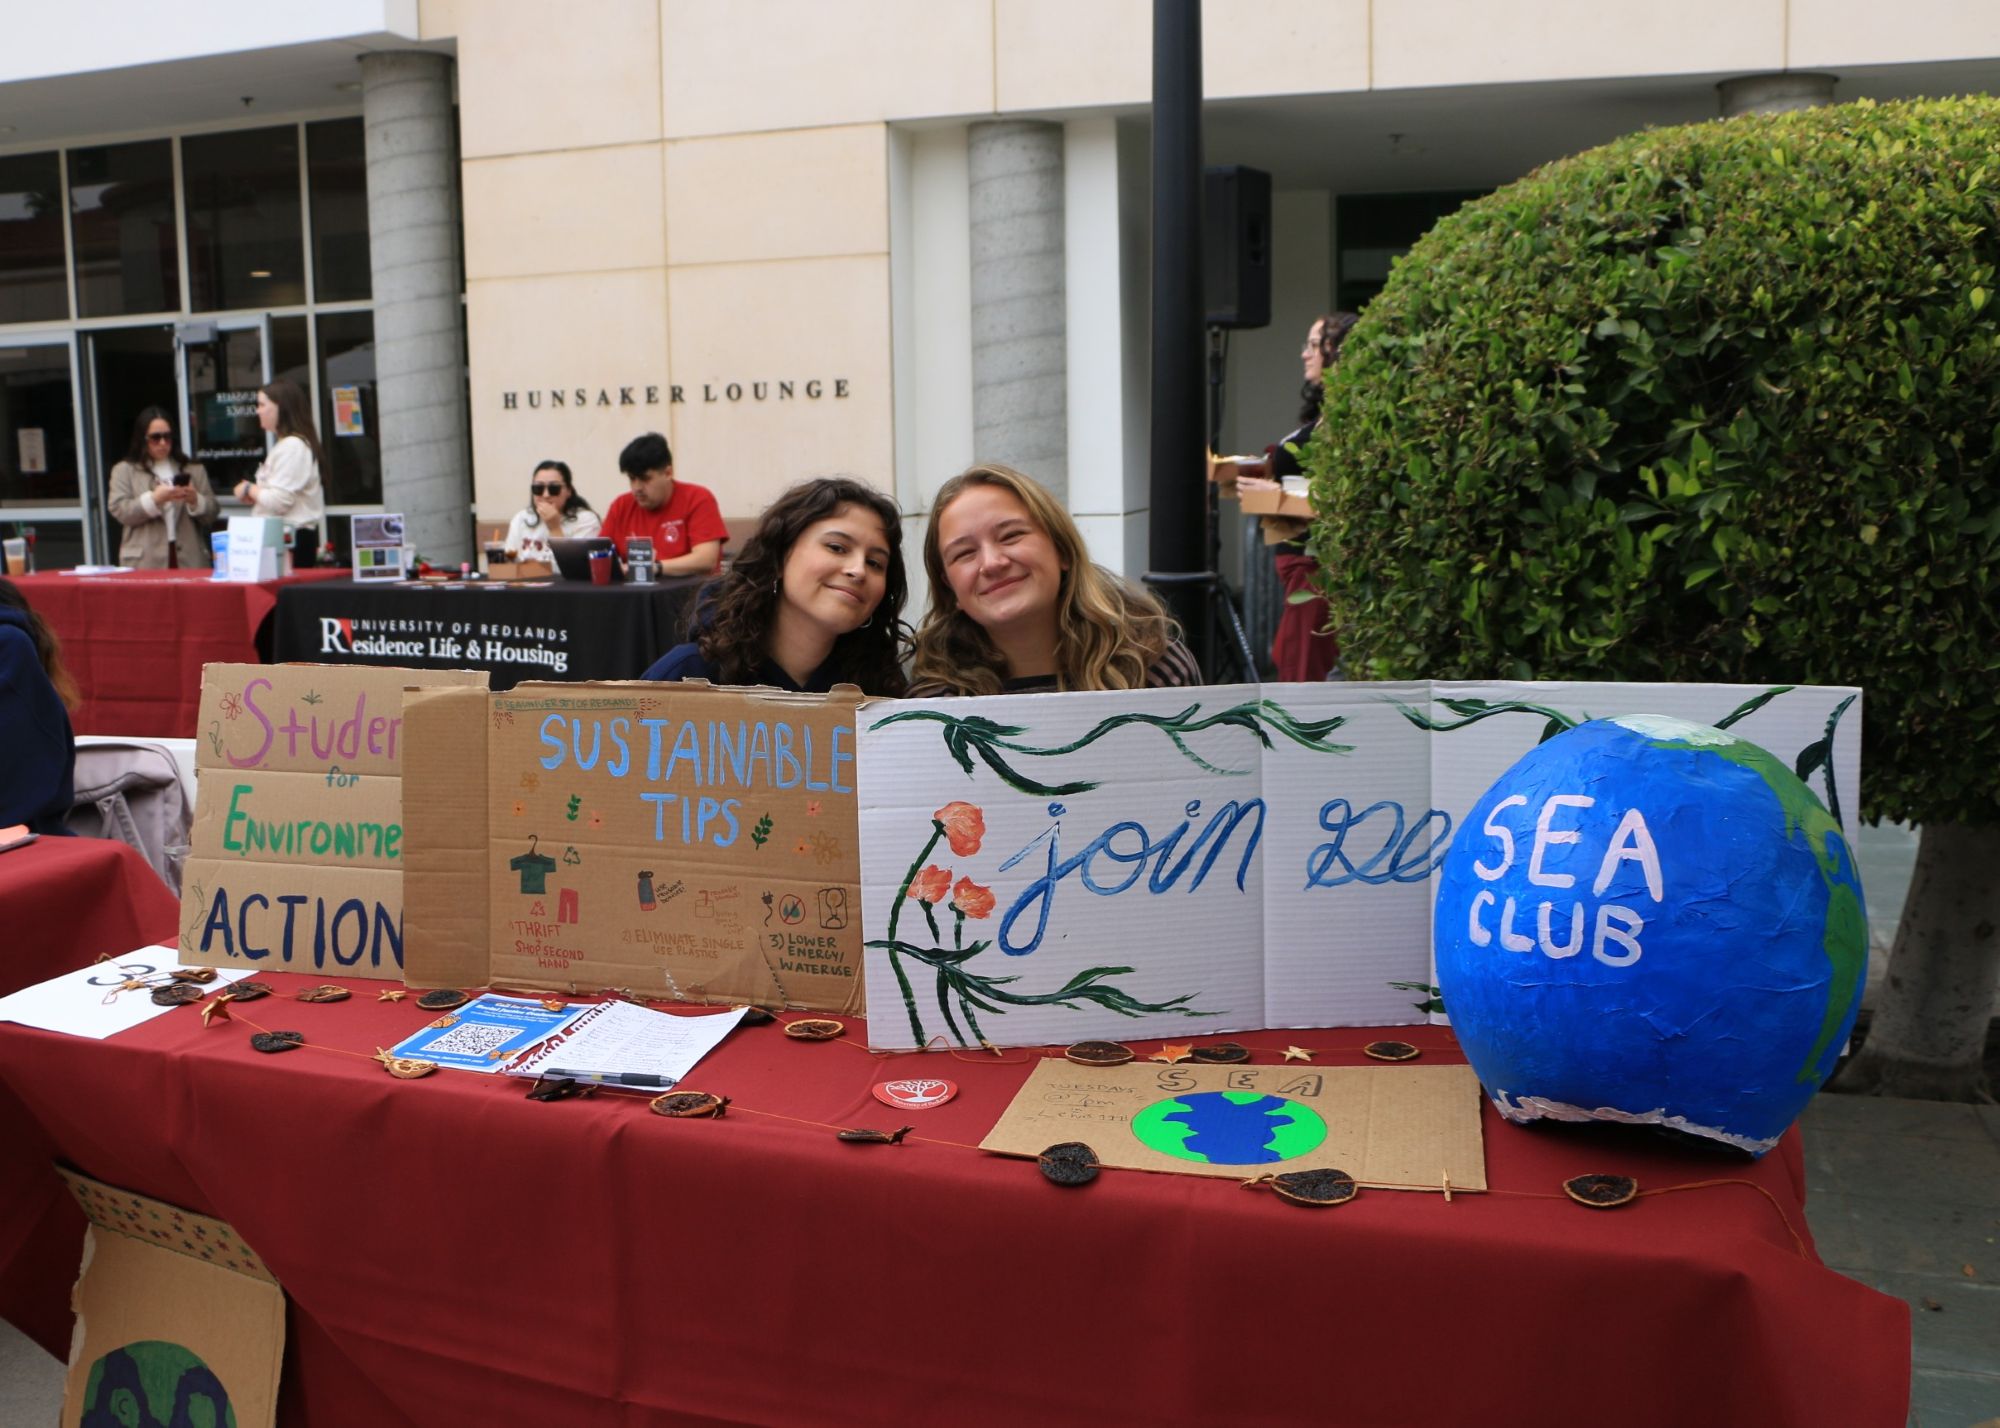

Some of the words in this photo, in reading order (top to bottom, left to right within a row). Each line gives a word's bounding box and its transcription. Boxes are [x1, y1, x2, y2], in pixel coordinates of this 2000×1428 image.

[503, 386, 686, 410] HUNSAKER
[704, 379, 849, 402] LOUNGE
[351, 619, 444, 635] UNIVERSITY
[452, 622, 473, 635] OF
[480, 624, 568, 642] REDLANDS
[319, 617, 425, 657] Residence
[429, 637, 462, 659] Life
[466, 640, 481, 660] &
[484, 641, 568, 673] Housing
[538, 713, 854, 793] SUSTAINABLE
[325, 765, 360, 788] for
[640, 793, 742, 848] TIPS
[1474, 795, 1663, 902] SEA
[999, 797, 1267, 957] join
[514, 920, 561, 938] THRIFT
[635, 929, 697, 947] ELIMINATE
[702, 937, 744, 950] SINGLE
[1469, 890, 1643, 967] CLUB
[515, 940, 541, 955] SHOP
[544, 945, 584, 961] SECOND
[653, 945, 674, 956] USE
[676, 945, 719, 960] PLASTICS
[768, 933, 784, 950] 3)
[788, 933, 837, 949] LOWER
[539, 959, 570, 969] HAND
[1157, 1069, 1323, 1097] SEA
